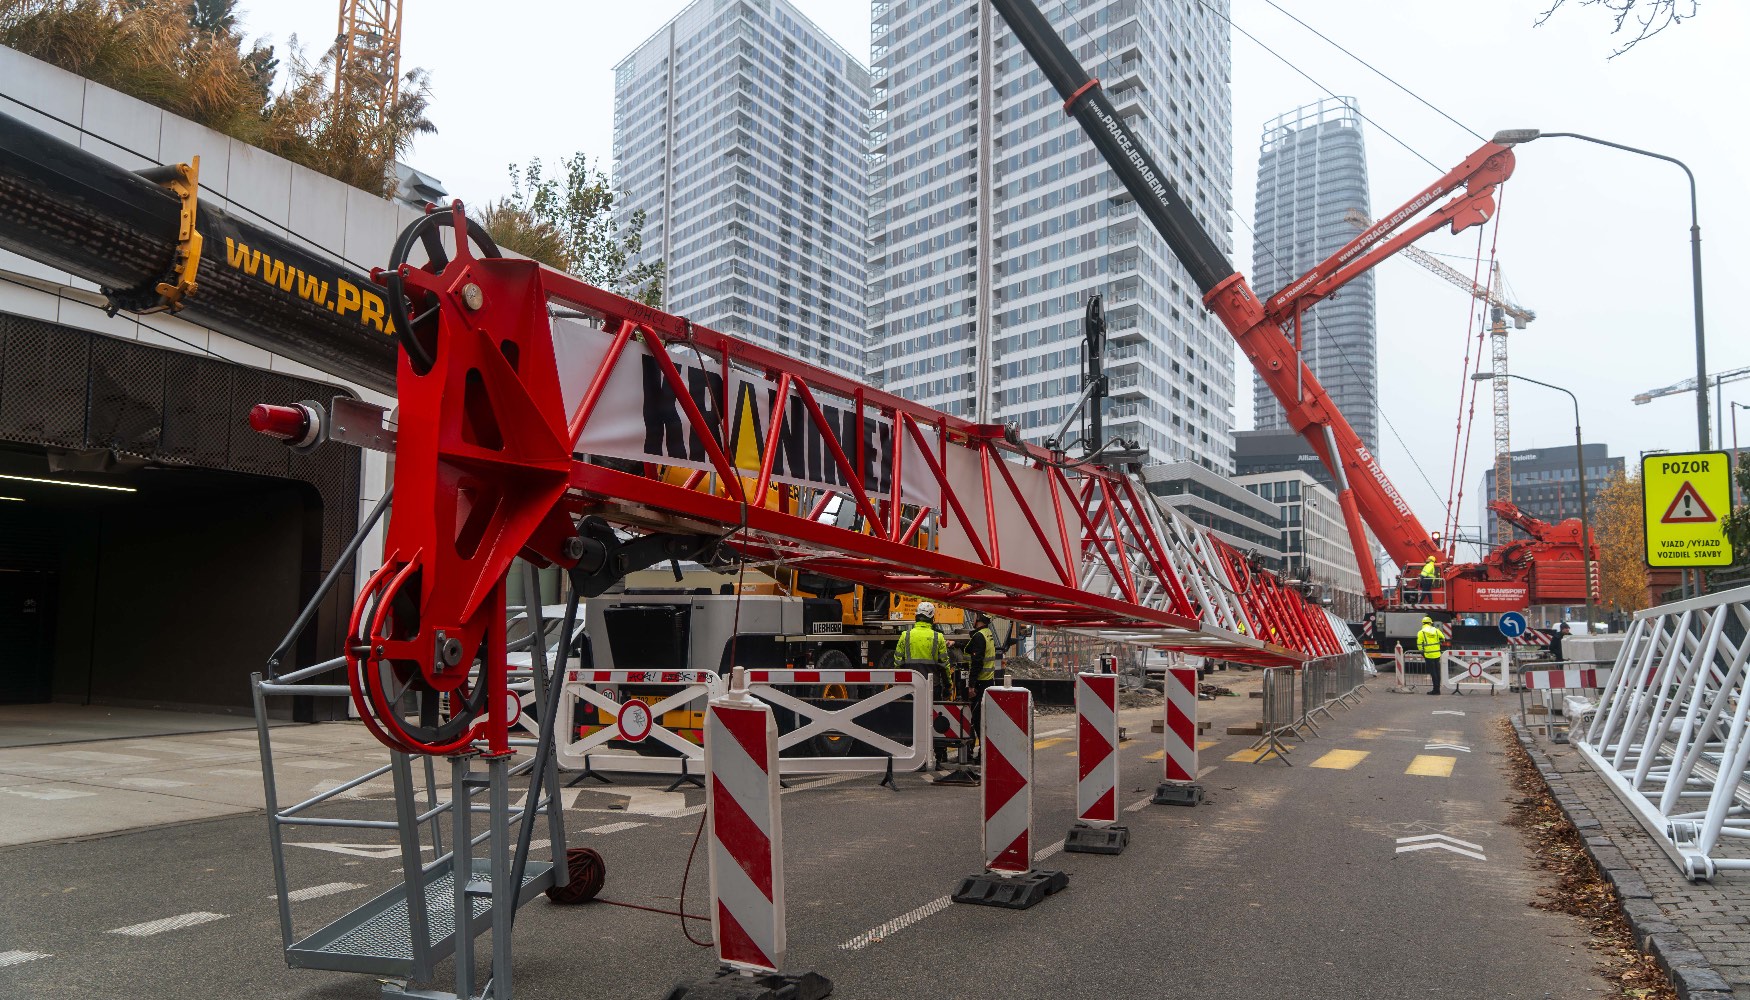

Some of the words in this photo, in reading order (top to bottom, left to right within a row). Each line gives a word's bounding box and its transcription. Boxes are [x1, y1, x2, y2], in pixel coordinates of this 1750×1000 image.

[1088, 98, 1170, 207] www.PRACEJERABEM.cz
[1338, 186, 1444, 262] www.PRACEJERABEM.cz
[1285, 272, 1319, 299] TRANSPORT
[1512, 454, 1537, 462] Deloitte
[1662, 460, 1710, 475] POZOR
[1355, 446, 1371, 462] AG
[1367, 459, 1412, 517] TRANSPORT
[1661, 540, 1685, 548] VJAZD
[1657, 551, 1691, 559] VOZIDIEL
[1694, 550, 1722, 558] STAVBY
[813, 622, 842, 634] LIEBHERR
